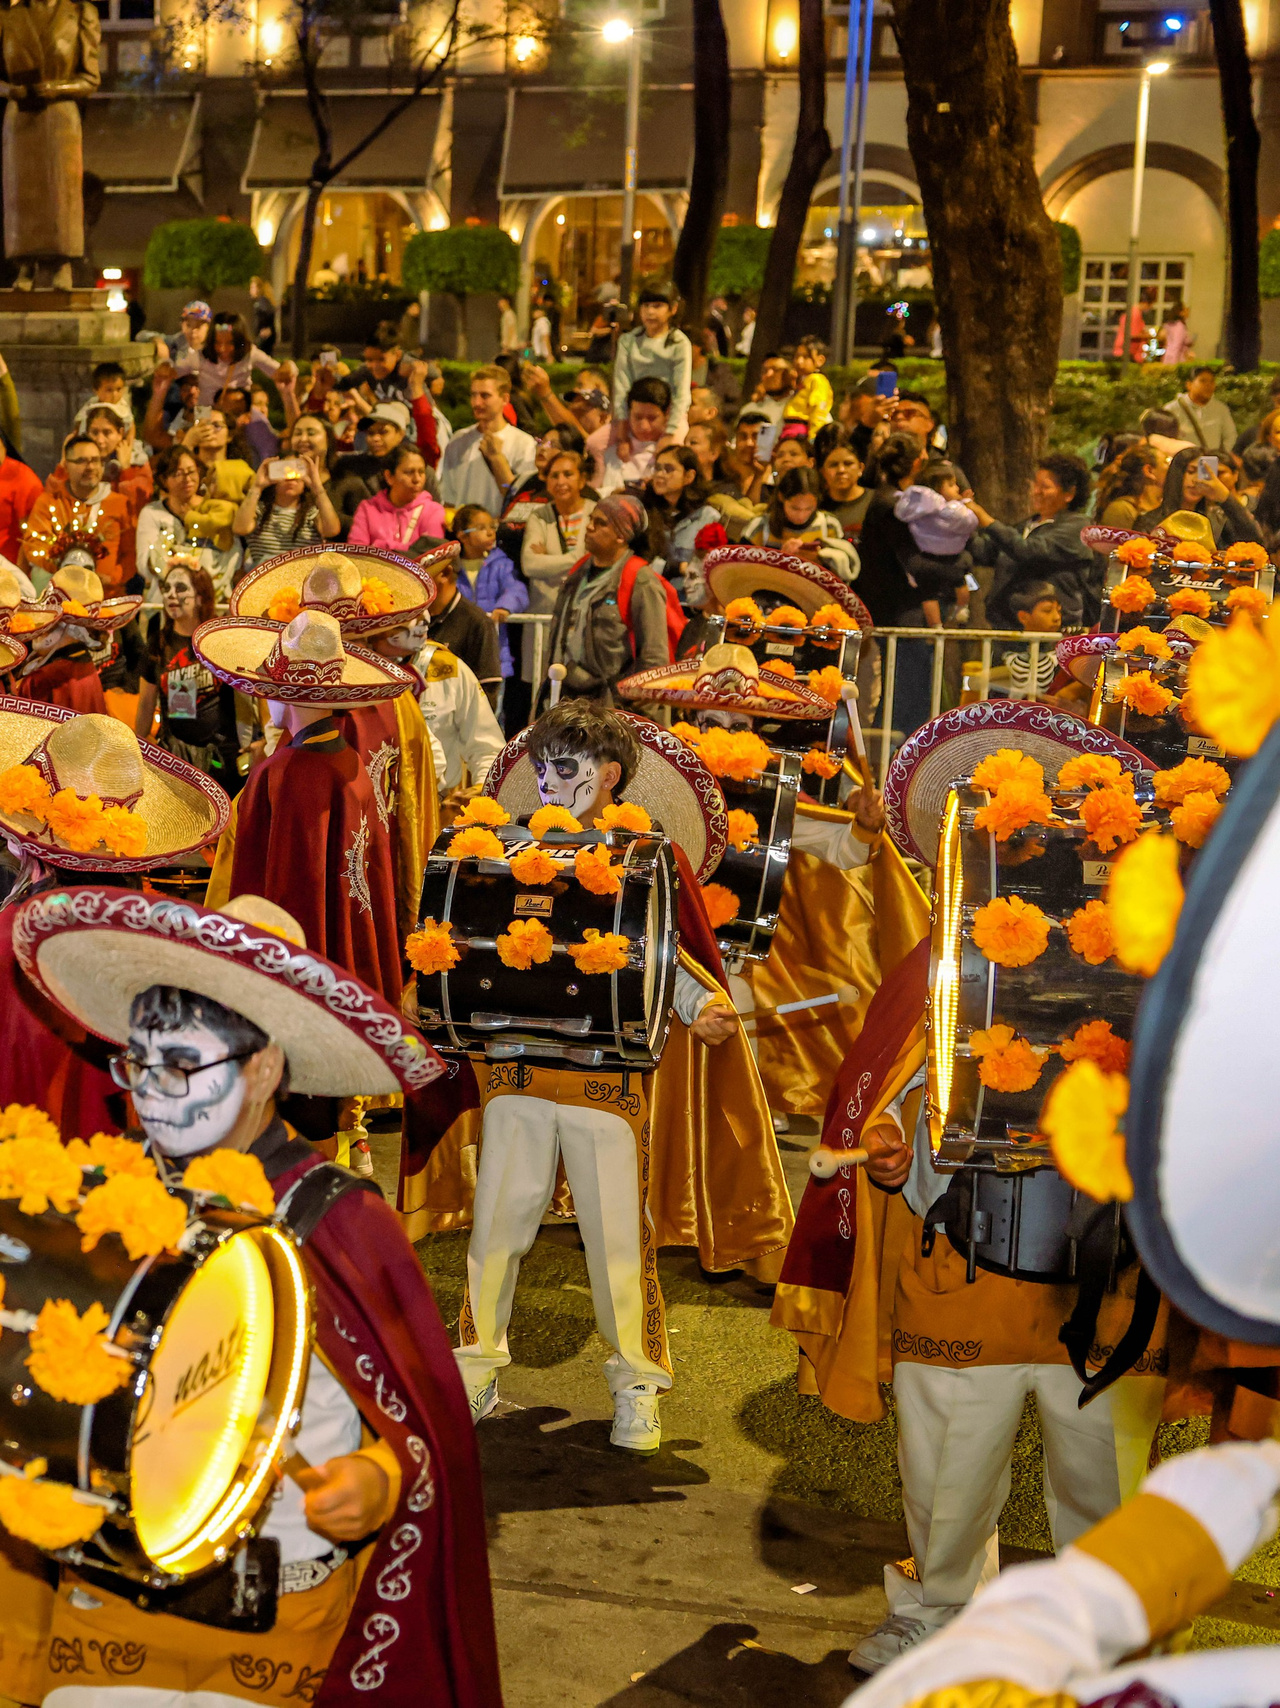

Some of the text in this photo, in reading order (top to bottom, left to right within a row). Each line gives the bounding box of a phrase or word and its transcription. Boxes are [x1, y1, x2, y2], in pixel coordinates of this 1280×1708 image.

[1161, 573, 1224, 591] Pearl
[1195, 738, 1221, 752] Pearl
[504, 840, 597, 859] Parl
